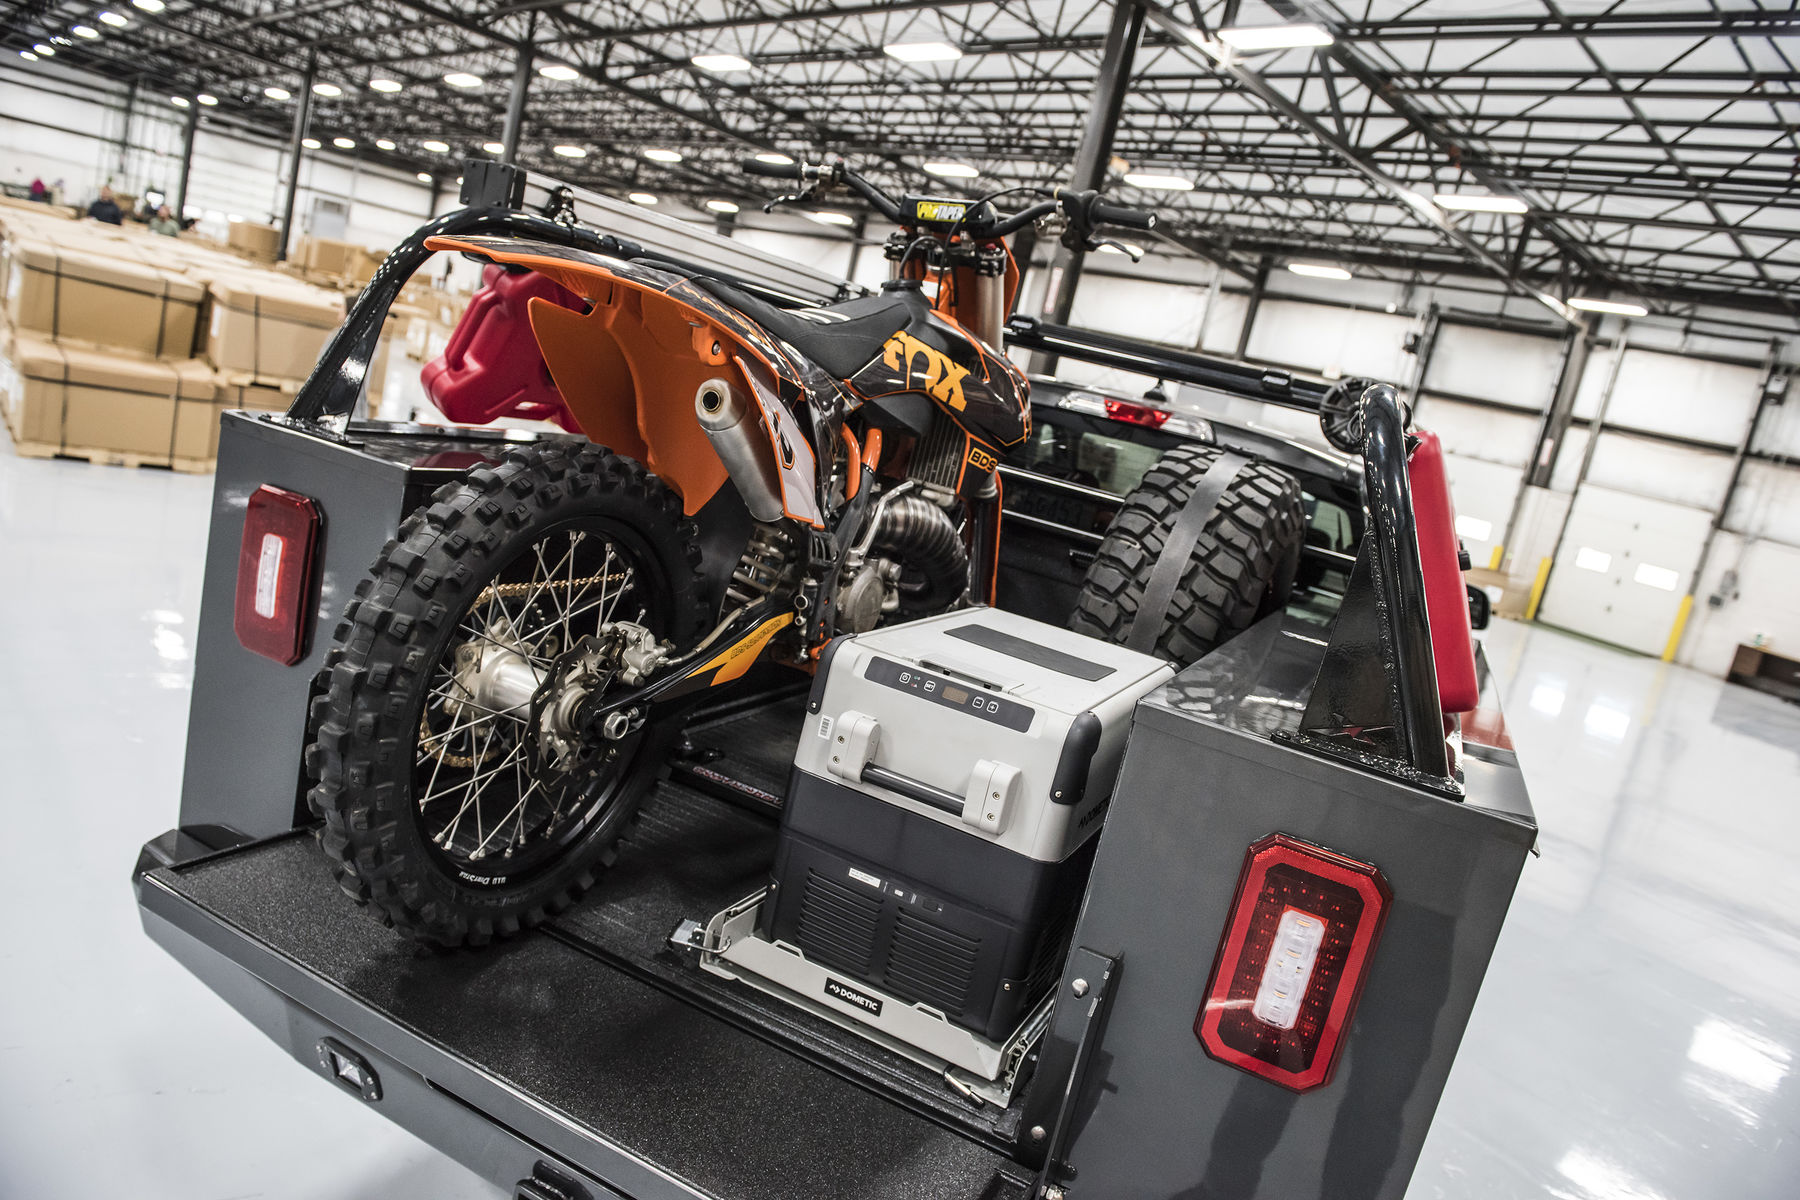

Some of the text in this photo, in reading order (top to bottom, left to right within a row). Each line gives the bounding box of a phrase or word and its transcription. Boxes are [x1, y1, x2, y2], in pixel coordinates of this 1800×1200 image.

[883, 330, 971, 412] FOX
[970, 450, 997, 472] BDS
[840, 988, 878, 1011] DOMETIC
